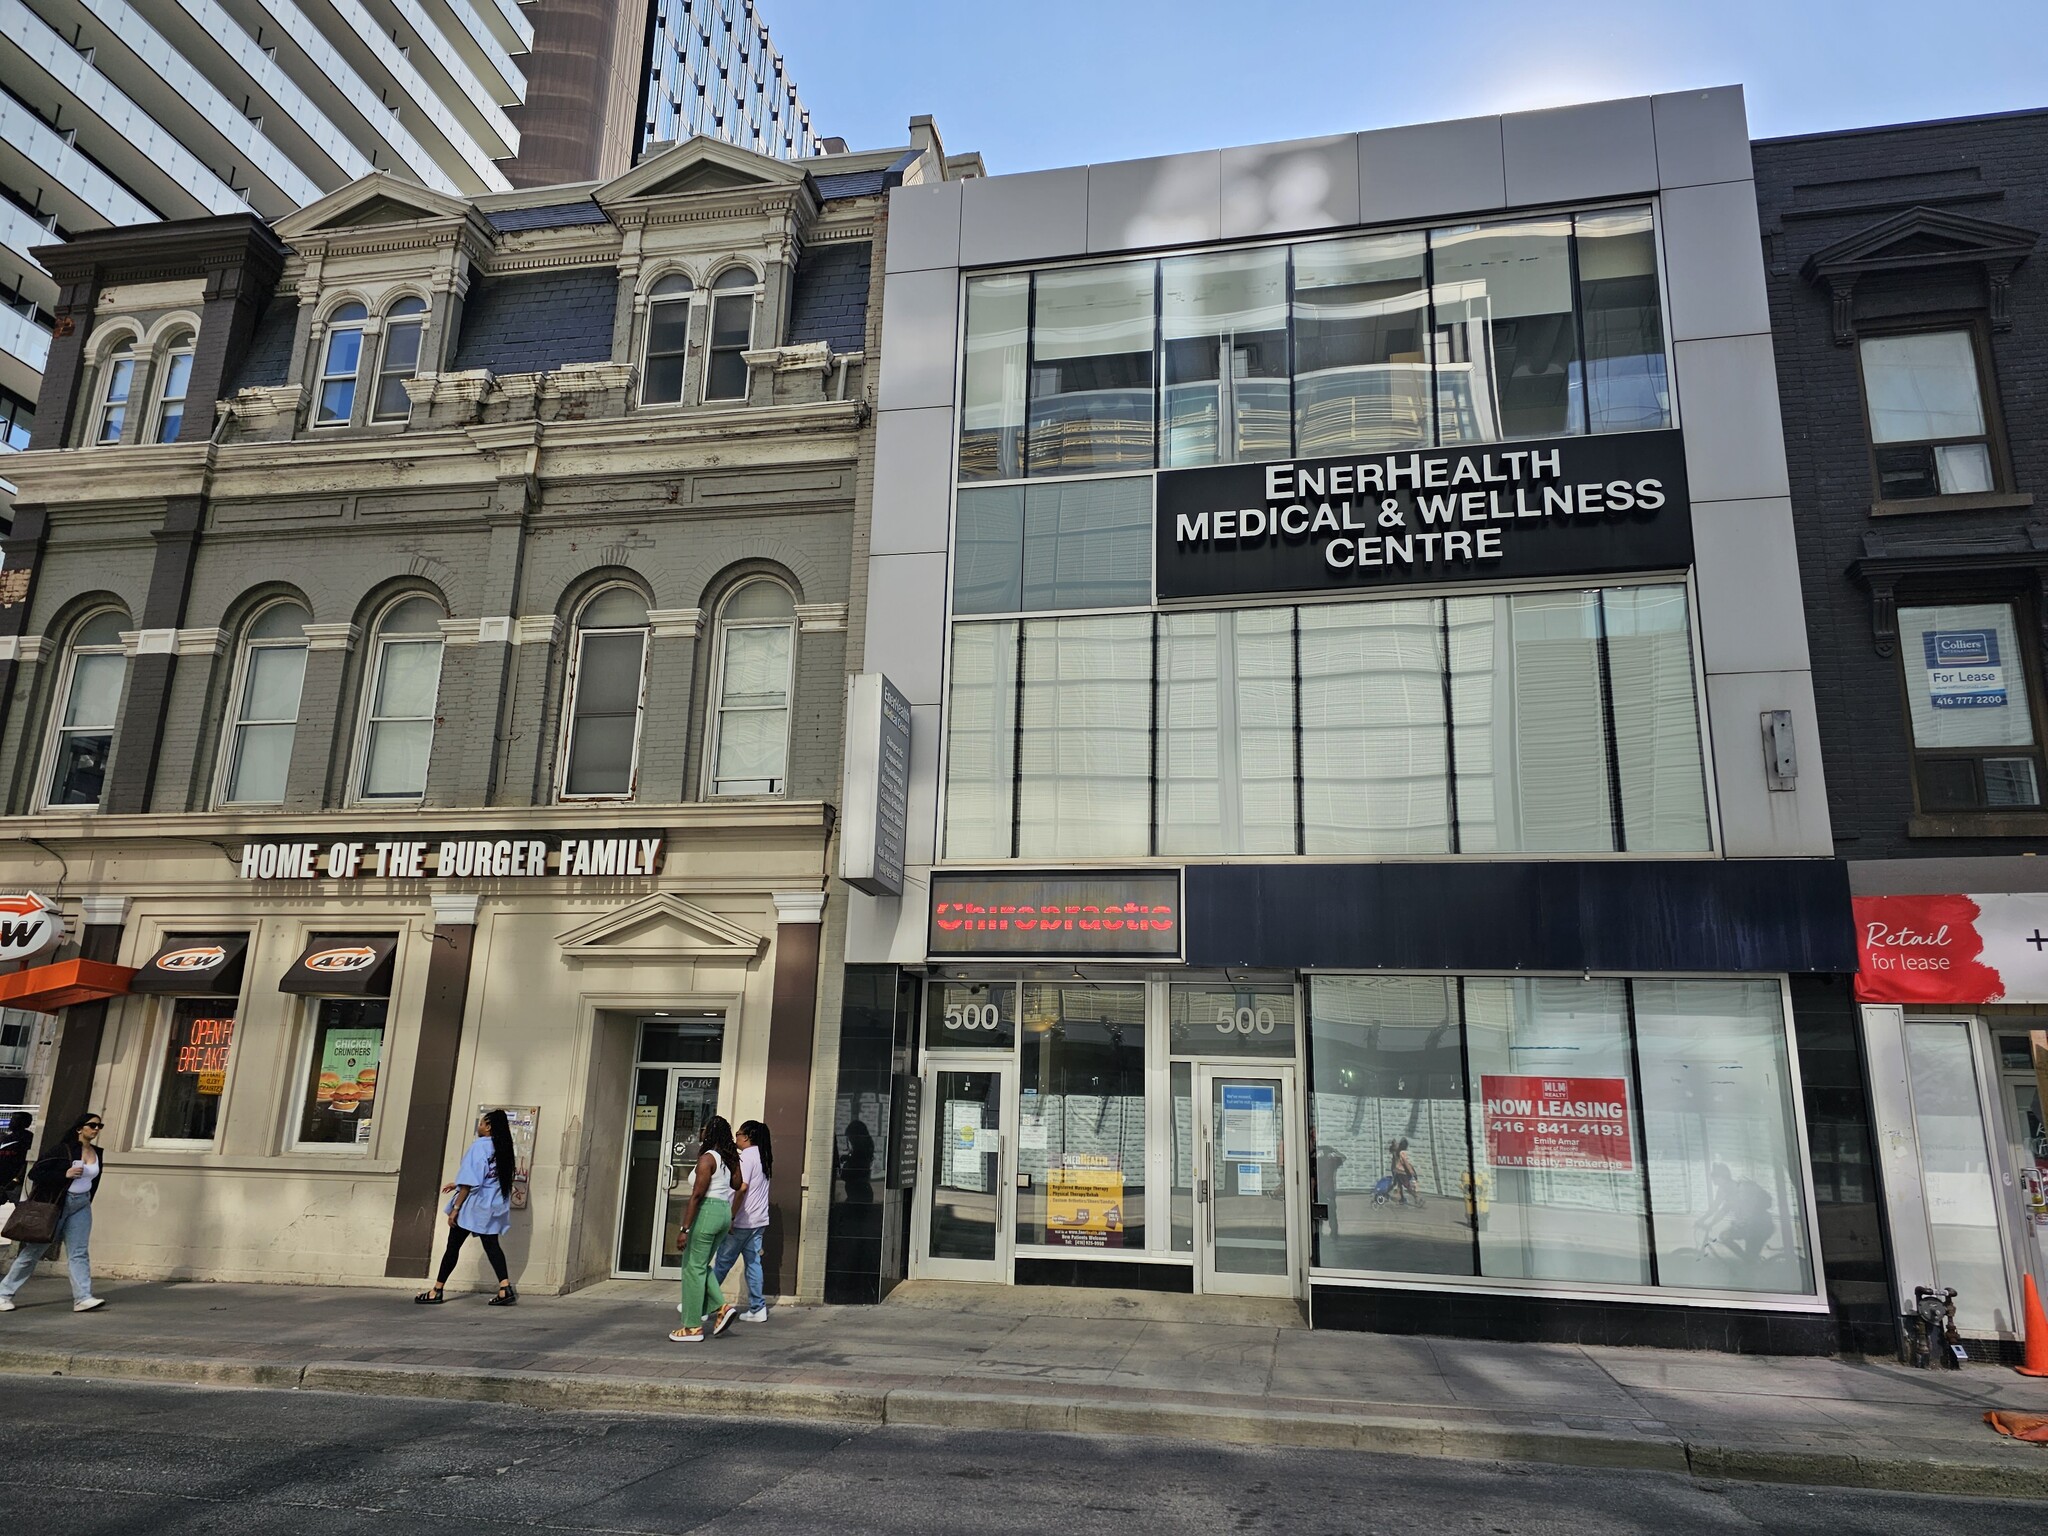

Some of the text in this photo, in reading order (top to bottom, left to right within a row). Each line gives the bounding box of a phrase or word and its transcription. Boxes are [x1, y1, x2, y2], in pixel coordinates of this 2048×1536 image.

[1265, 448, 1561, 500] ENERHEALTH
[1176, 479, 1665, 541] MEDICAL & WELLNESS
[1326, 528, 1503, 568] CENTRE
[1941, 640, 1982, 650] Colliers
[1933, 671, 1995, 683] For Lease
[1936, 695, 2002, 705] 416 777 2200
[240, 838, 662, 879] HOME OF THE BURGER FAMILY
[0, 920, 45, 948] W
[1866, 922, 1952, 950] Retail
[166, 956, 221, 967] A&W
[314, 956, 370, 967] A&W
[1871, 952, 1950, 971] for lease
[944, 1004, 998, 1030] 500
[1215, 1007, 1275, 1035] 500
[191, 1019, 222, 1045] OPEN
[333, 1047, 371, 1056] CRUNCHERS
[335, 1040, 371, 1048] CHICKEN
[1543, 1082, 1566, 1092] MLM
[1488, 1099, 1623, 1119] NOW LEASING
[1491, 1121, 1525, 1133] 416
[1534, 1137, 1556, 1145] Emile
[1497, 1155, 1523, 1165] MLM
[1565, 1158, 1623, 1170] Brokerage
